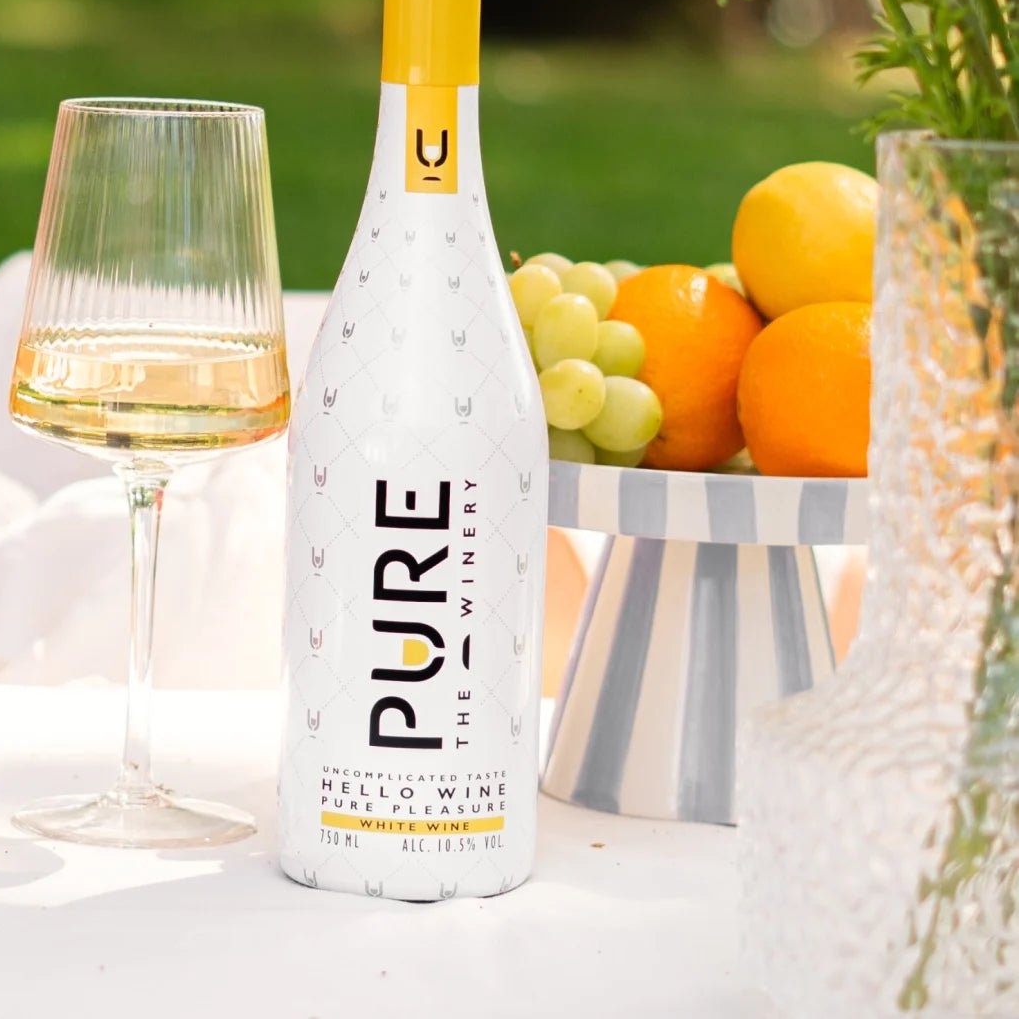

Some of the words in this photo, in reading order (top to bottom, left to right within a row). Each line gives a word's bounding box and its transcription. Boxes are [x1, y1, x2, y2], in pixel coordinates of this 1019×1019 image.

[460, 479, 478, 618] WINERY
[369, 479, 451, 750] PURE
[456, 690, 471, 749] THE
[323, 766, 458, 782] UNCOMPLICATED
[468, 770, 506, 780] TASTE
[322, 778, 414, 799] HELLO
[438, 784, 506, 799] WINE
[322, 796, 374, 812] PURE
[392, 800, 506, 814] PLEASURE
[360, 820, 416, 832] WHITE
[427, 822, 470, 831] WINE
[320, 829, 339, 846] 750
[345, 834, 359, 848] ML
[402, 838, 430, 852] ALC.
[438, 838, 476, 852] 10.5%
[484, 835, 504, 849] VOL.
